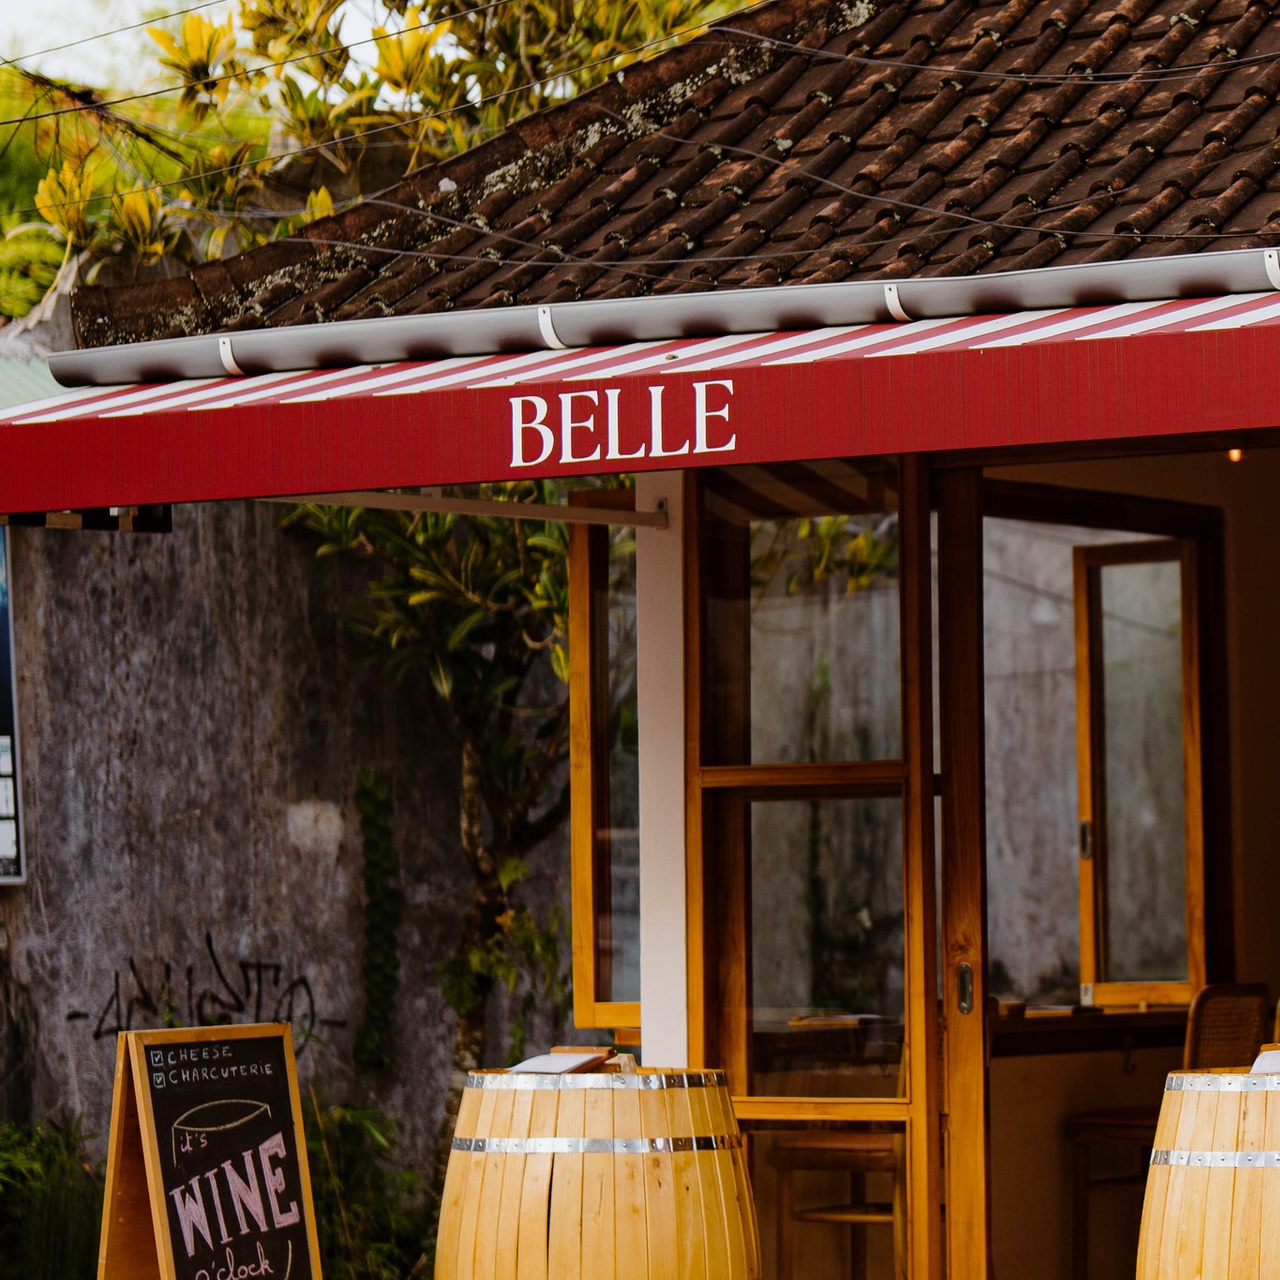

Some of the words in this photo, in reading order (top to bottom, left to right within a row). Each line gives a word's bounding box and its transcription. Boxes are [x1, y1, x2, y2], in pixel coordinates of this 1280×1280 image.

[509, 379, 737, 468] BELLE
[167, 1046, 232, 1066] CHEESE
[168, 1061, 273, 1084] CHARCUTERIE
[180, 1132, 208, 1154] it's
[169, 1131, 300, 1258] WINE
